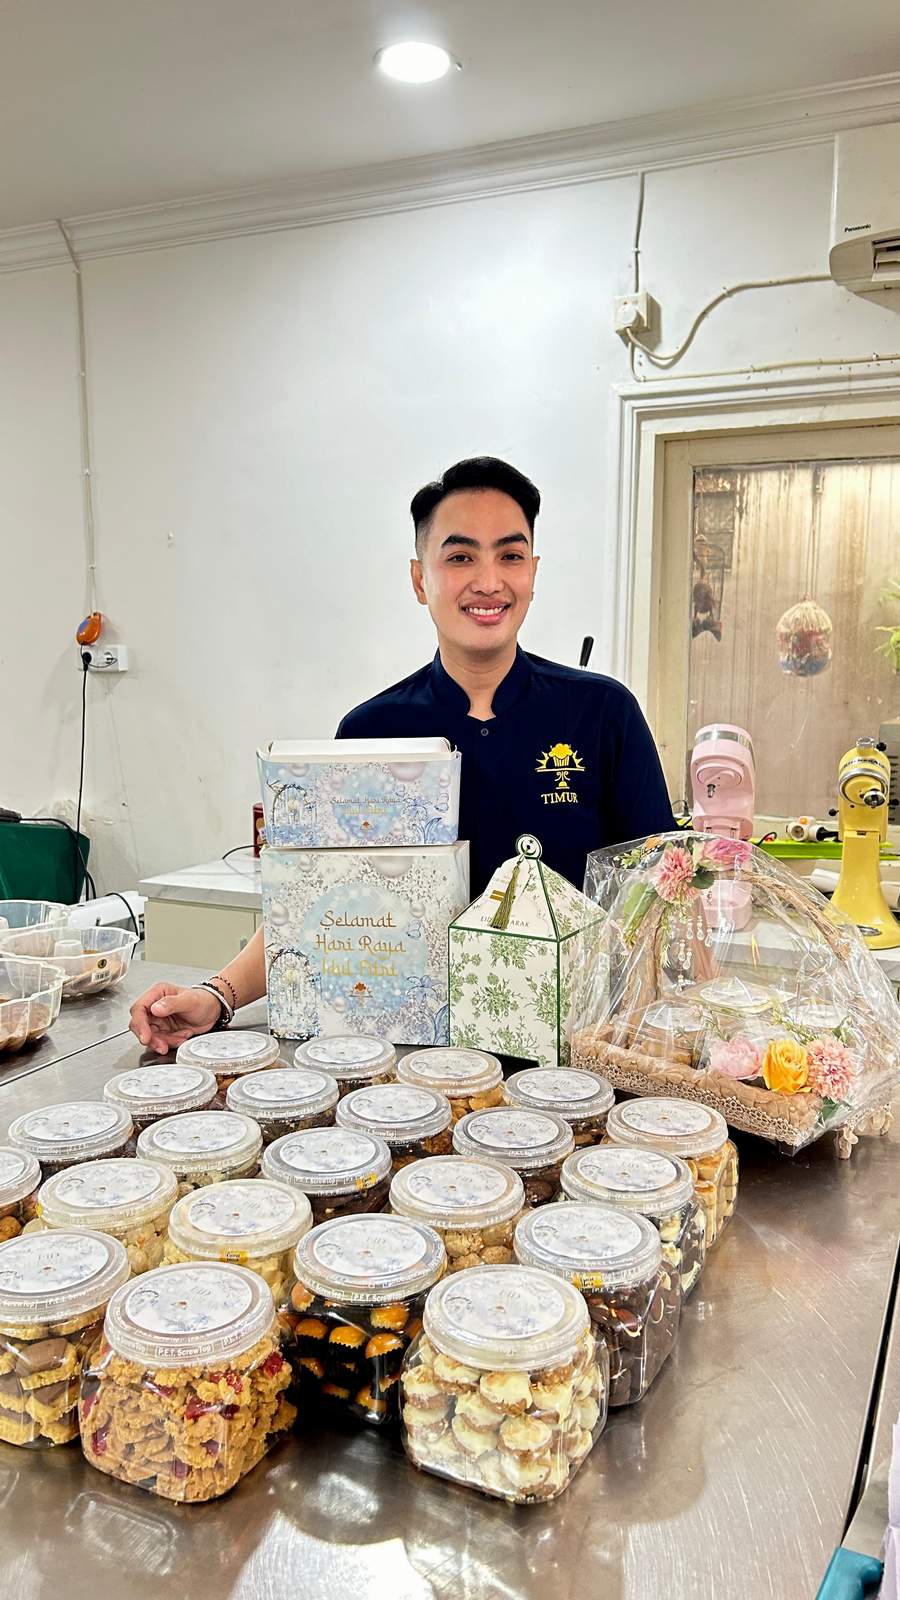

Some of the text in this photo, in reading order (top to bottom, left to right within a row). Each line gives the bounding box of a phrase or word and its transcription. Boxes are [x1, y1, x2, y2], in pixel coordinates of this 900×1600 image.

[844, 223, 872, 233] Panasonic
[540, 791, 579, 804] TIMUR
[320, 910, 397, 930] Selamat
[313, 933, 407, 959] Hari Raya
[178, 1344, 212, 1357] ScrewTop
